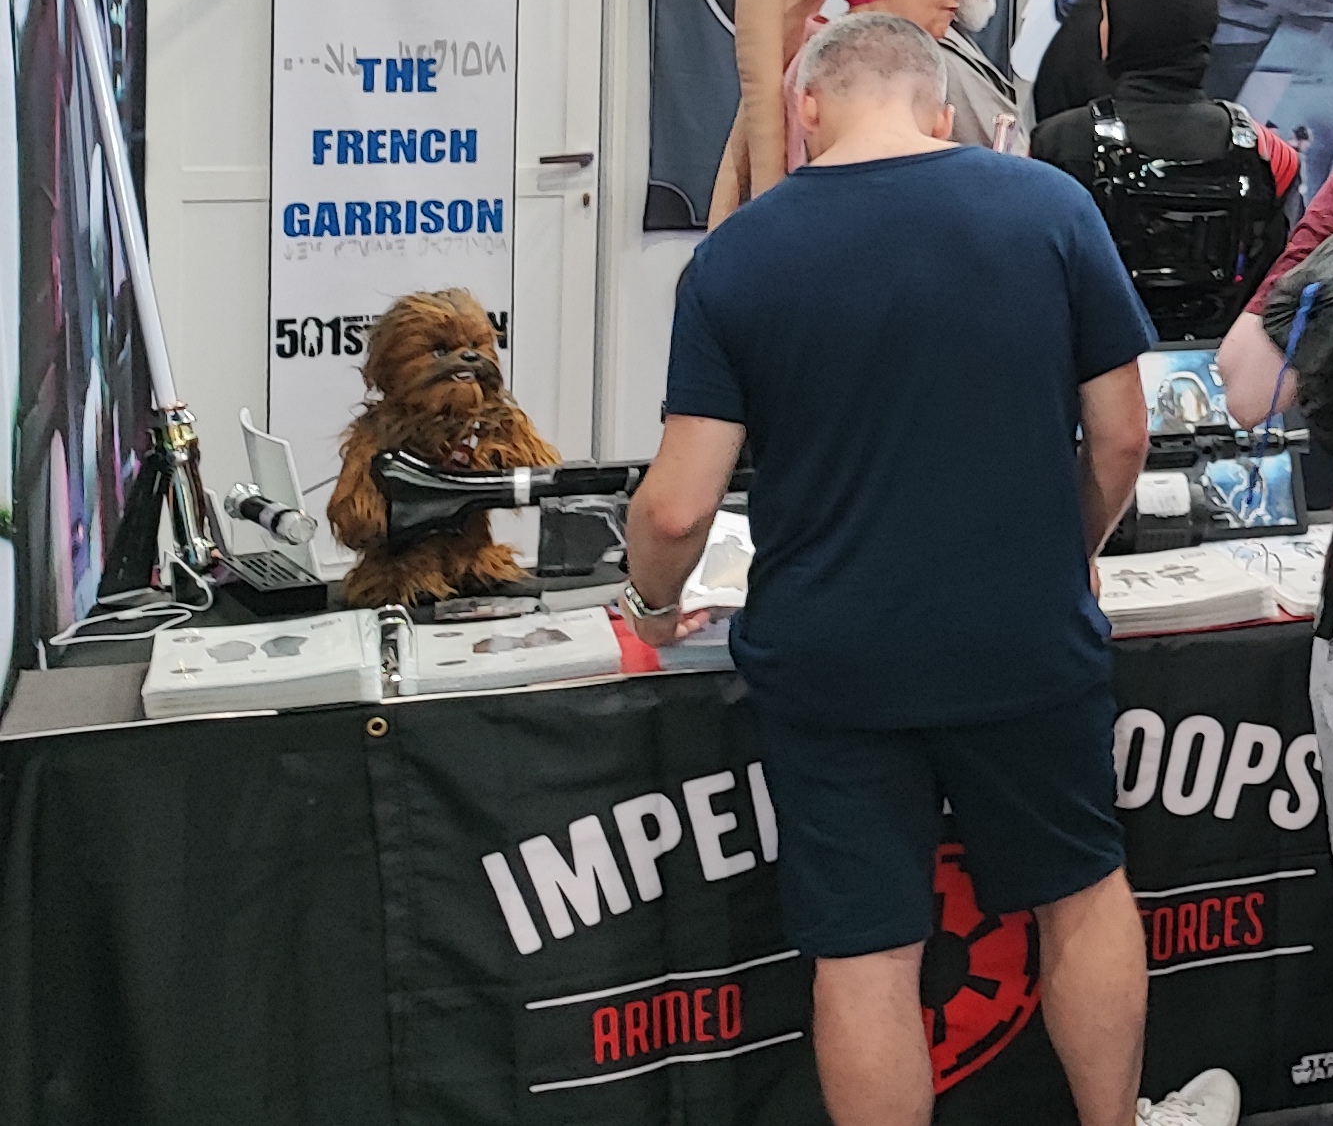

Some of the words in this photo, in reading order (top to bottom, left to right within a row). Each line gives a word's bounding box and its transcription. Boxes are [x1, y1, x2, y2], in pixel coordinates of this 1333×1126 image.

[355, 57, 437, 93] THE
[312, 128, 478, 165] FRENCH
[282, 198, 504, 238] GARRISON
[275, 316, 370, 359] 501S
[1112, 708, 1323, 831] OOPS
[592, 983, 743, 1065] ARMED
